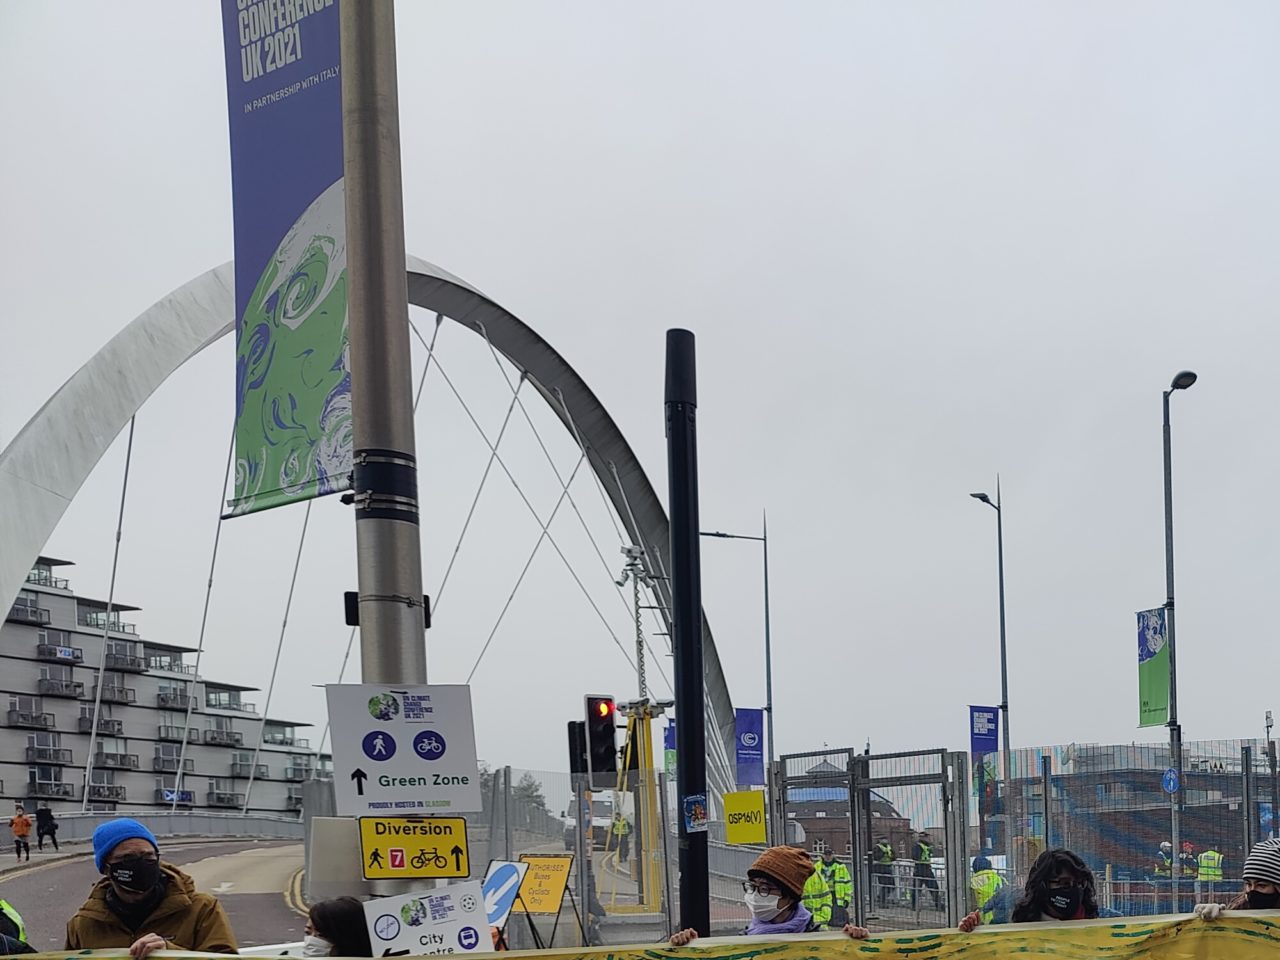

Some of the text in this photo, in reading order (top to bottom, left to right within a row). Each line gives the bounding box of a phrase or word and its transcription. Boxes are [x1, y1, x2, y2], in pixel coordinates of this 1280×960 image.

[241, 23, 302, 82] UK 2021
[244, 65, 341, 113] IN PARTNERSHIP WITH ITALY
[378, 774, 470, 787] Green Zone
[395, 801, 416, 809] HOSTED
[728, 810, 762, 825] OSP16(V)
[375, 821, 453, 836] Diversion
[391, 851, 402, 866] 7
[419, 934, 444, 946] City
